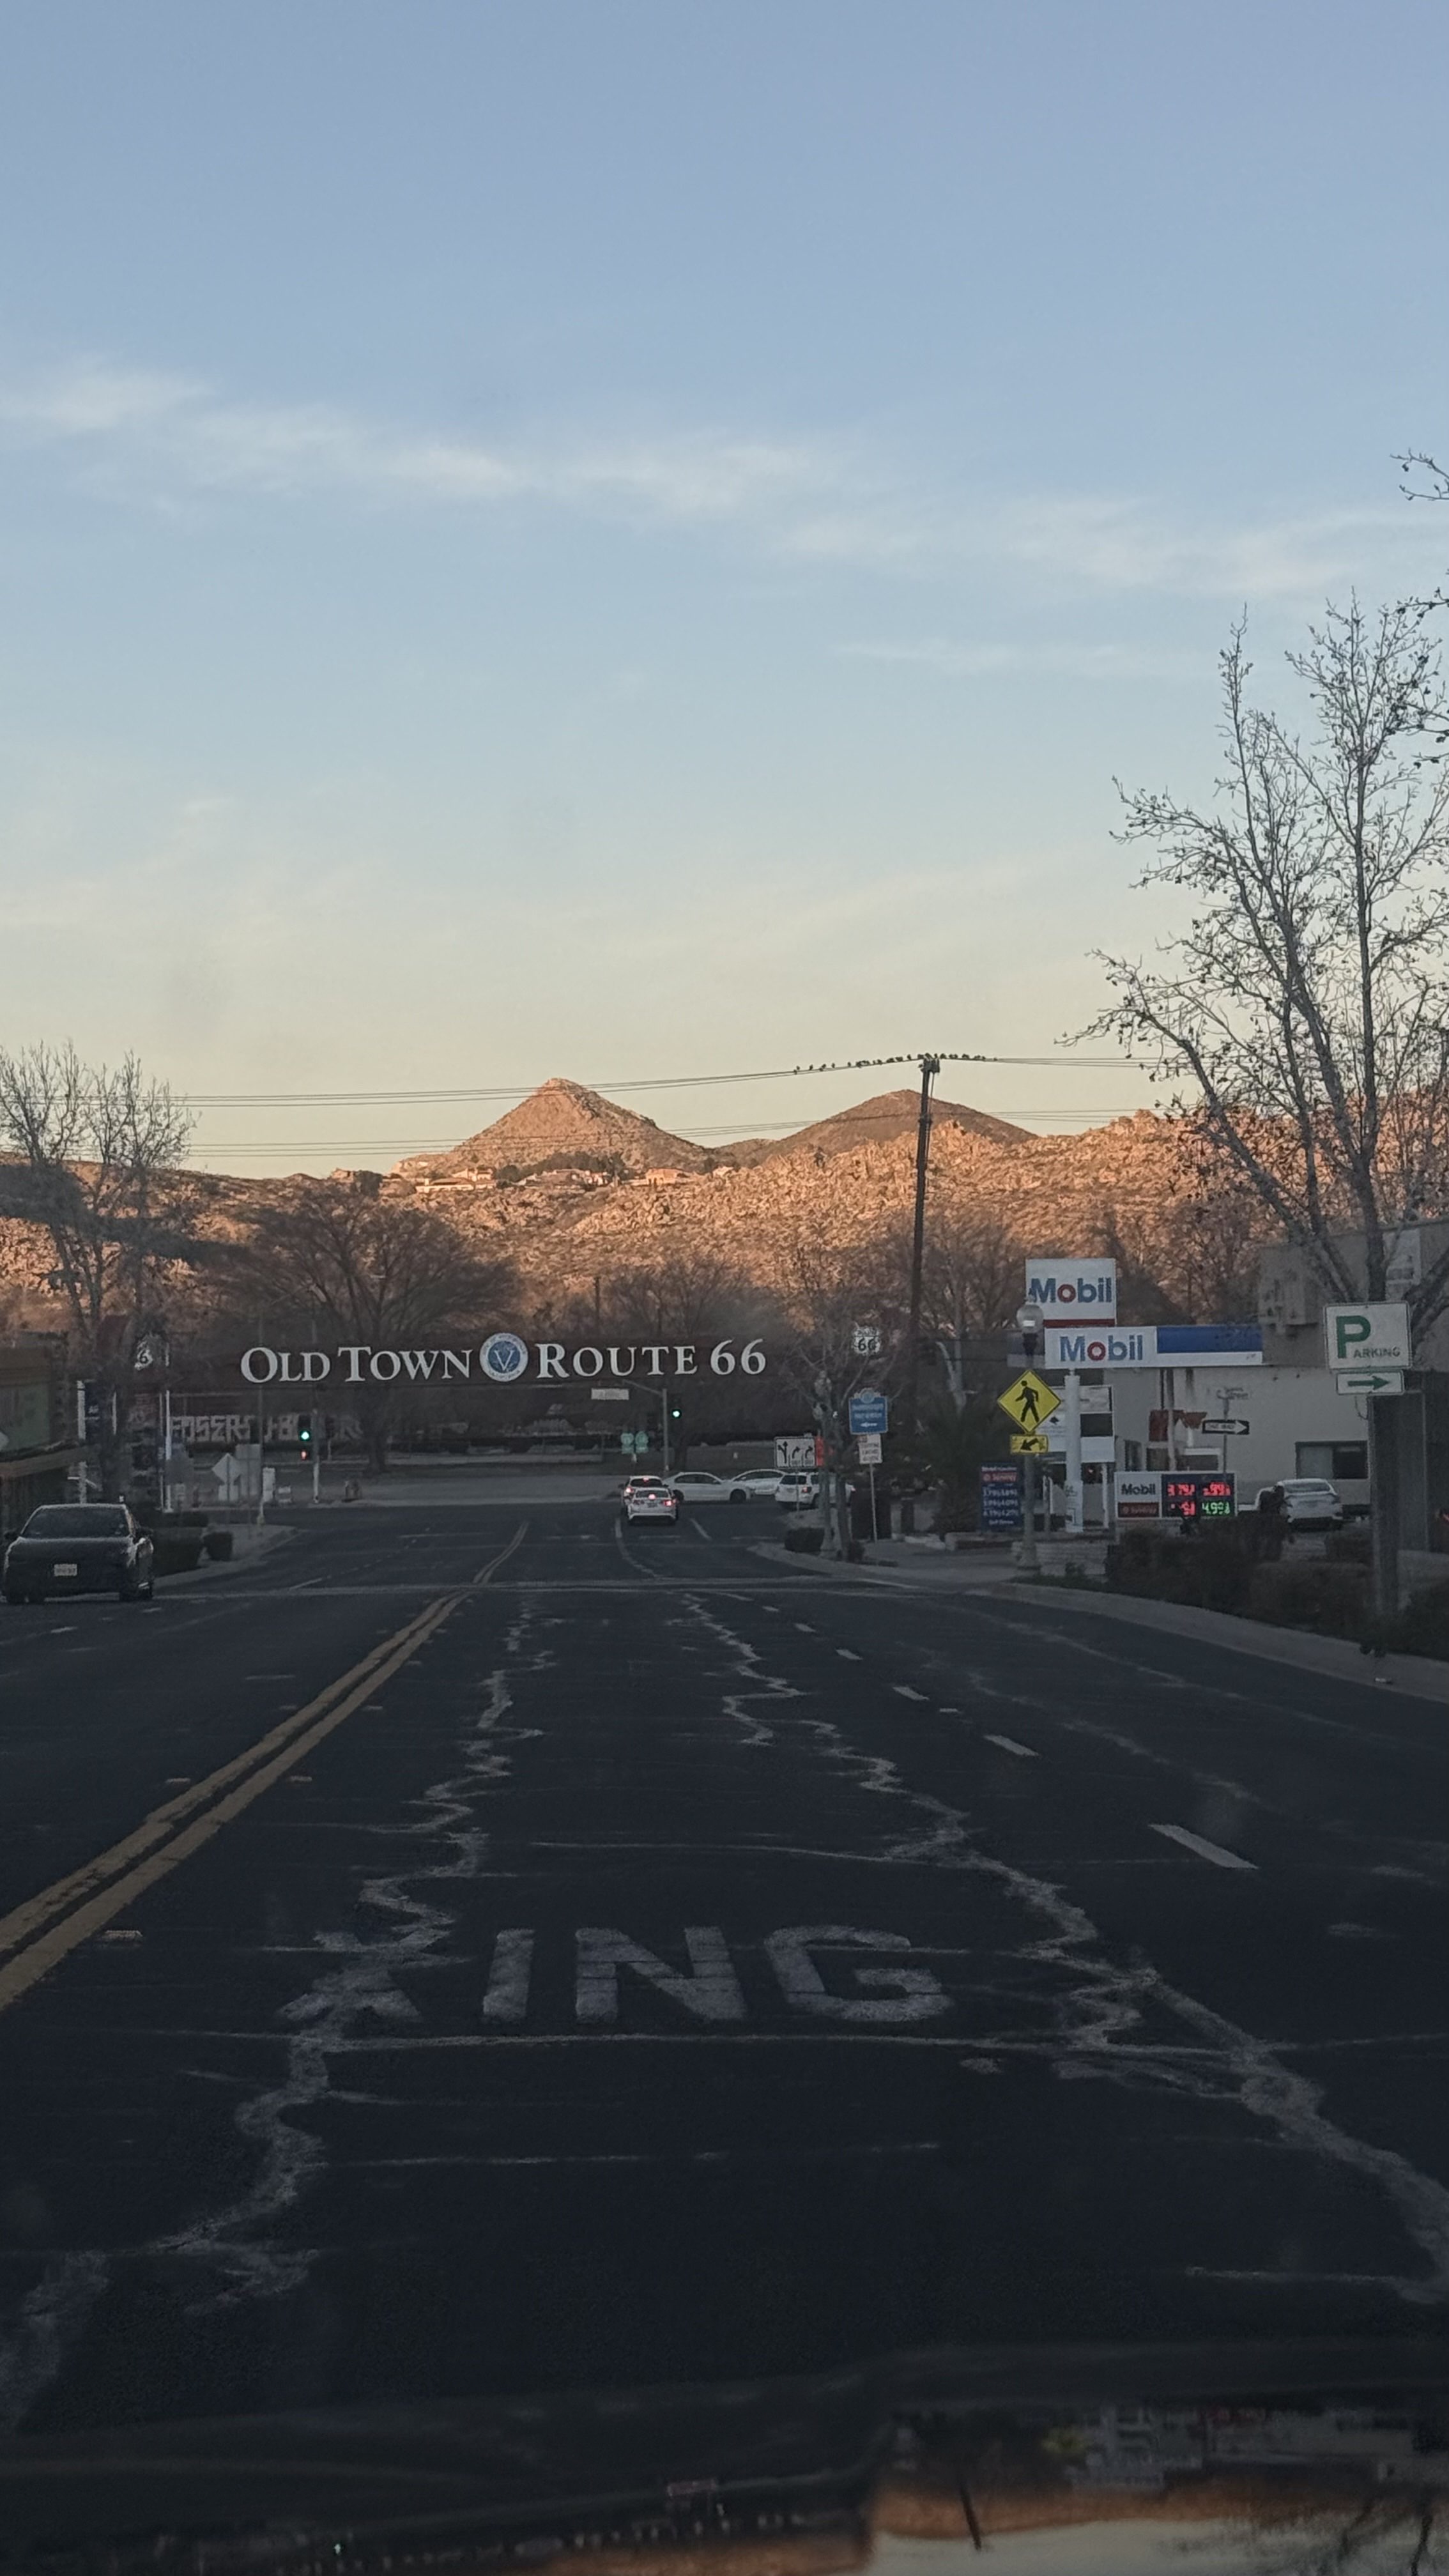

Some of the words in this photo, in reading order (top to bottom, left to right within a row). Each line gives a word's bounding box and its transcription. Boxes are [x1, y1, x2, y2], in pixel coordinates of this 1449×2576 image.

[1029, 1278, 1112, 1303] Mobil
[240, 1347, 330, 1383] OLD
[337, 1346, 473, 1382] TOWN
[535, 1342, 698, 1378] ROUTE
[710, 1338, 766, 1376] 66
[1059, 1335, 1143, 1361] Mobil
[1121, 1483, 1156, 1495] Mobil
